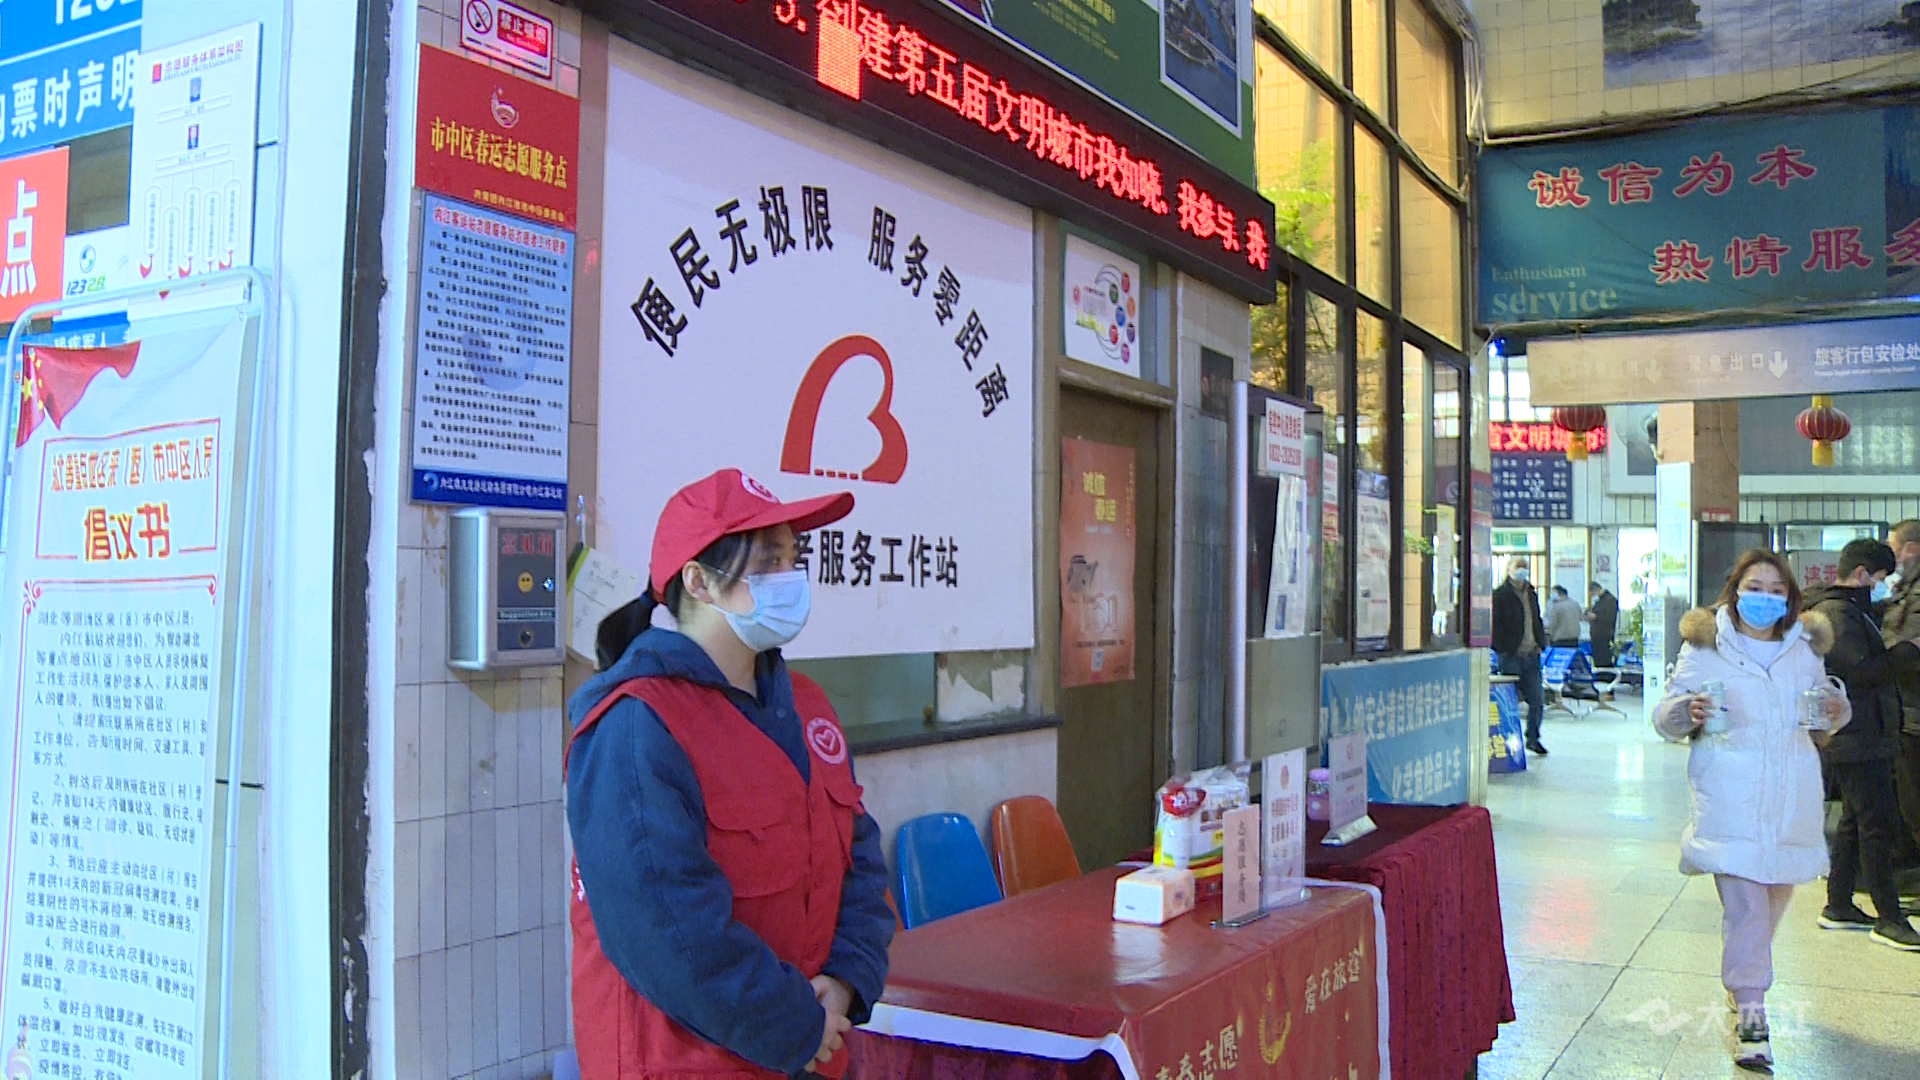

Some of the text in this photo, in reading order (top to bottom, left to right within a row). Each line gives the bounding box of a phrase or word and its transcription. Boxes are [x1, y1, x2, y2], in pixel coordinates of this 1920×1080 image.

[500, 11, 548, 46] 禁止吸烟
[0, 48, 139, 144] 票时声明
[430, 115, 568, 189] 市中区春运志愿服务点
[1528, 144, 1818, 209] 诚信为本
[0, 178, 38, 299] 点
[1650, 217, 1920, 286] 热情服务
[629, 185, 835, 359] 便民无极限
[867, 205, 1010, 419] 服务零距离
[1491, 280, 1618, 316] service
[1814, 342, 1920, 367] 旅客行包安检处
[84, 501, 171, 562] 倡议书
[1305, 947, 1362, 1014] 爱在旅途
